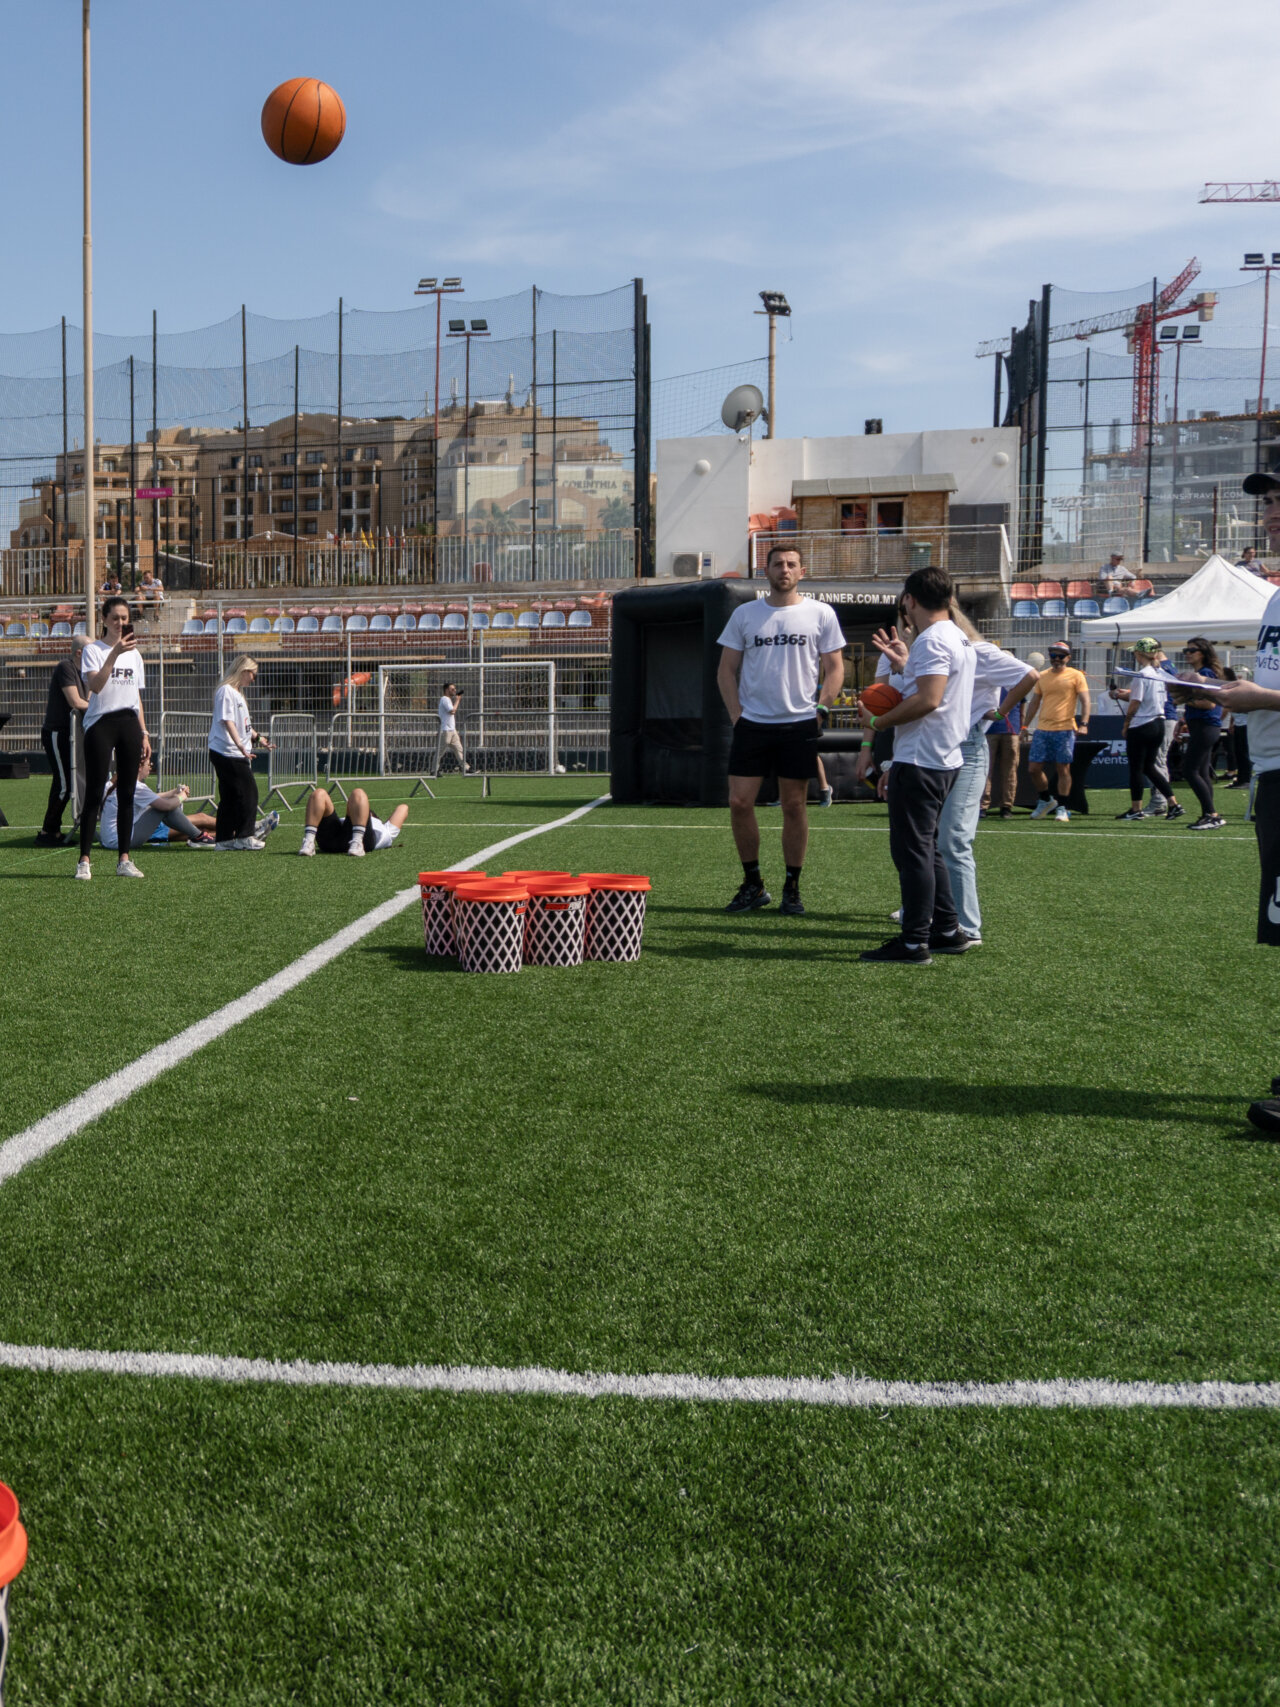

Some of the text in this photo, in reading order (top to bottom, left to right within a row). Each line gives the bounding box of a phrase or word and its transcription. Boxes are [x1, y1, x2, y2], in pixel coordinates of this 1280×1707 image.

[562, 480, 617, 489] CORINTHIA
[754, 633, 807, 647] bet365
[1091, 756, 1128, 765] events
